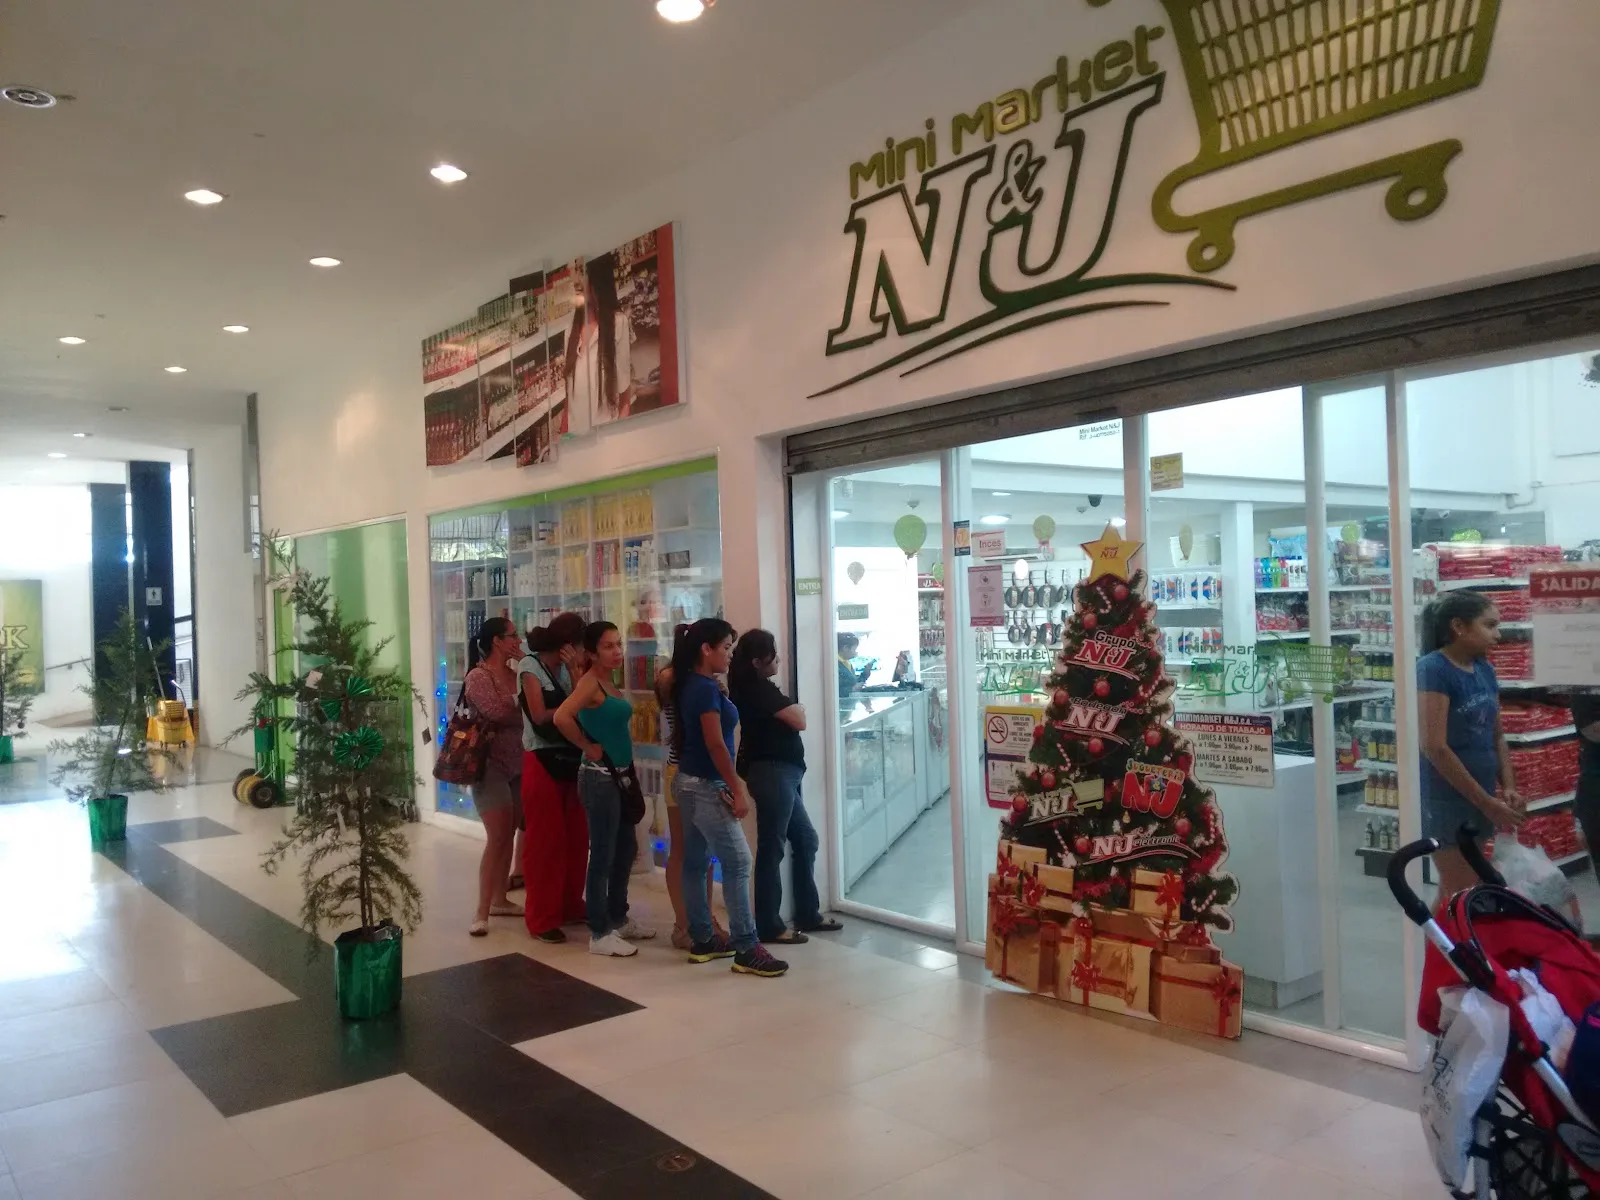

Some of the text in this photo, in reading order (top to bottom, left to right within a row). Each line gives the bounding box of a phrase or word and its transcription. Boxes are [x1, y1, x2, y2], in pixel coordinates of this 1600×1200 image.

[848, 24, 1165, 201] Mini Market
[826, 72, 1166, 356] N&J
[1540, 576, 1600, 592] SALIDA
[1095, 630, 1136, 649] Grupo
[1074, 638, 1137, 669] N&J
[1180, 723, 1266, 735] HORARIO DE TRABAJO
